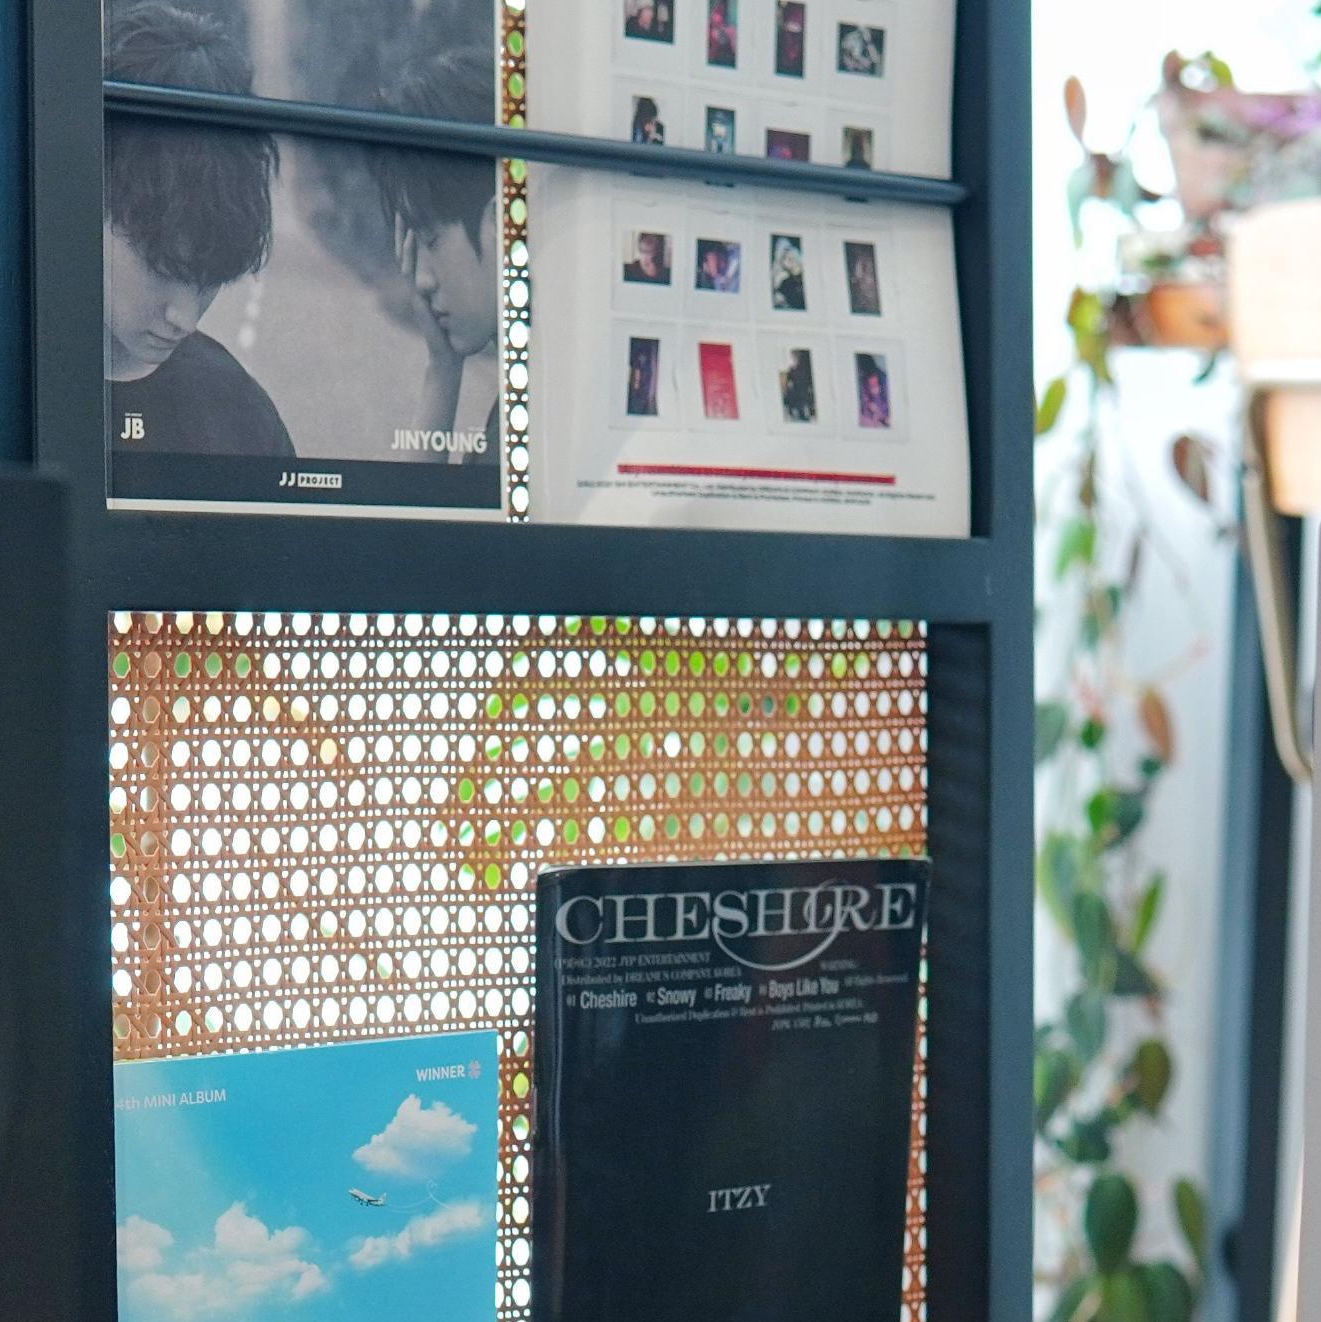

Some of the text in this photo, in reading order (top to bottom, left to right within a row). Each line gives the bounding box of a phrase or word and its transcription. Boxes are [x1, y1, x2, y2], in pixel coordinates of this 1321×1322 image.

[121, 417, 146, 440] JB
[391, 428, 488, 454] JINYOUNG
[299, 474, 341, 487] PROJECT
[554, 881, 918, 947] CHESHIRE
[580, 988, 638, 1009] Cheshire
[657, 985, 697, 1008] Snowy
[416, 1064, 466, 1082] WINNER
[144, 1093, 177, 1109] MINI
[179, 1088, 227, 1106] ALBUM
[707, 1183, 772, 1213] ITZY
